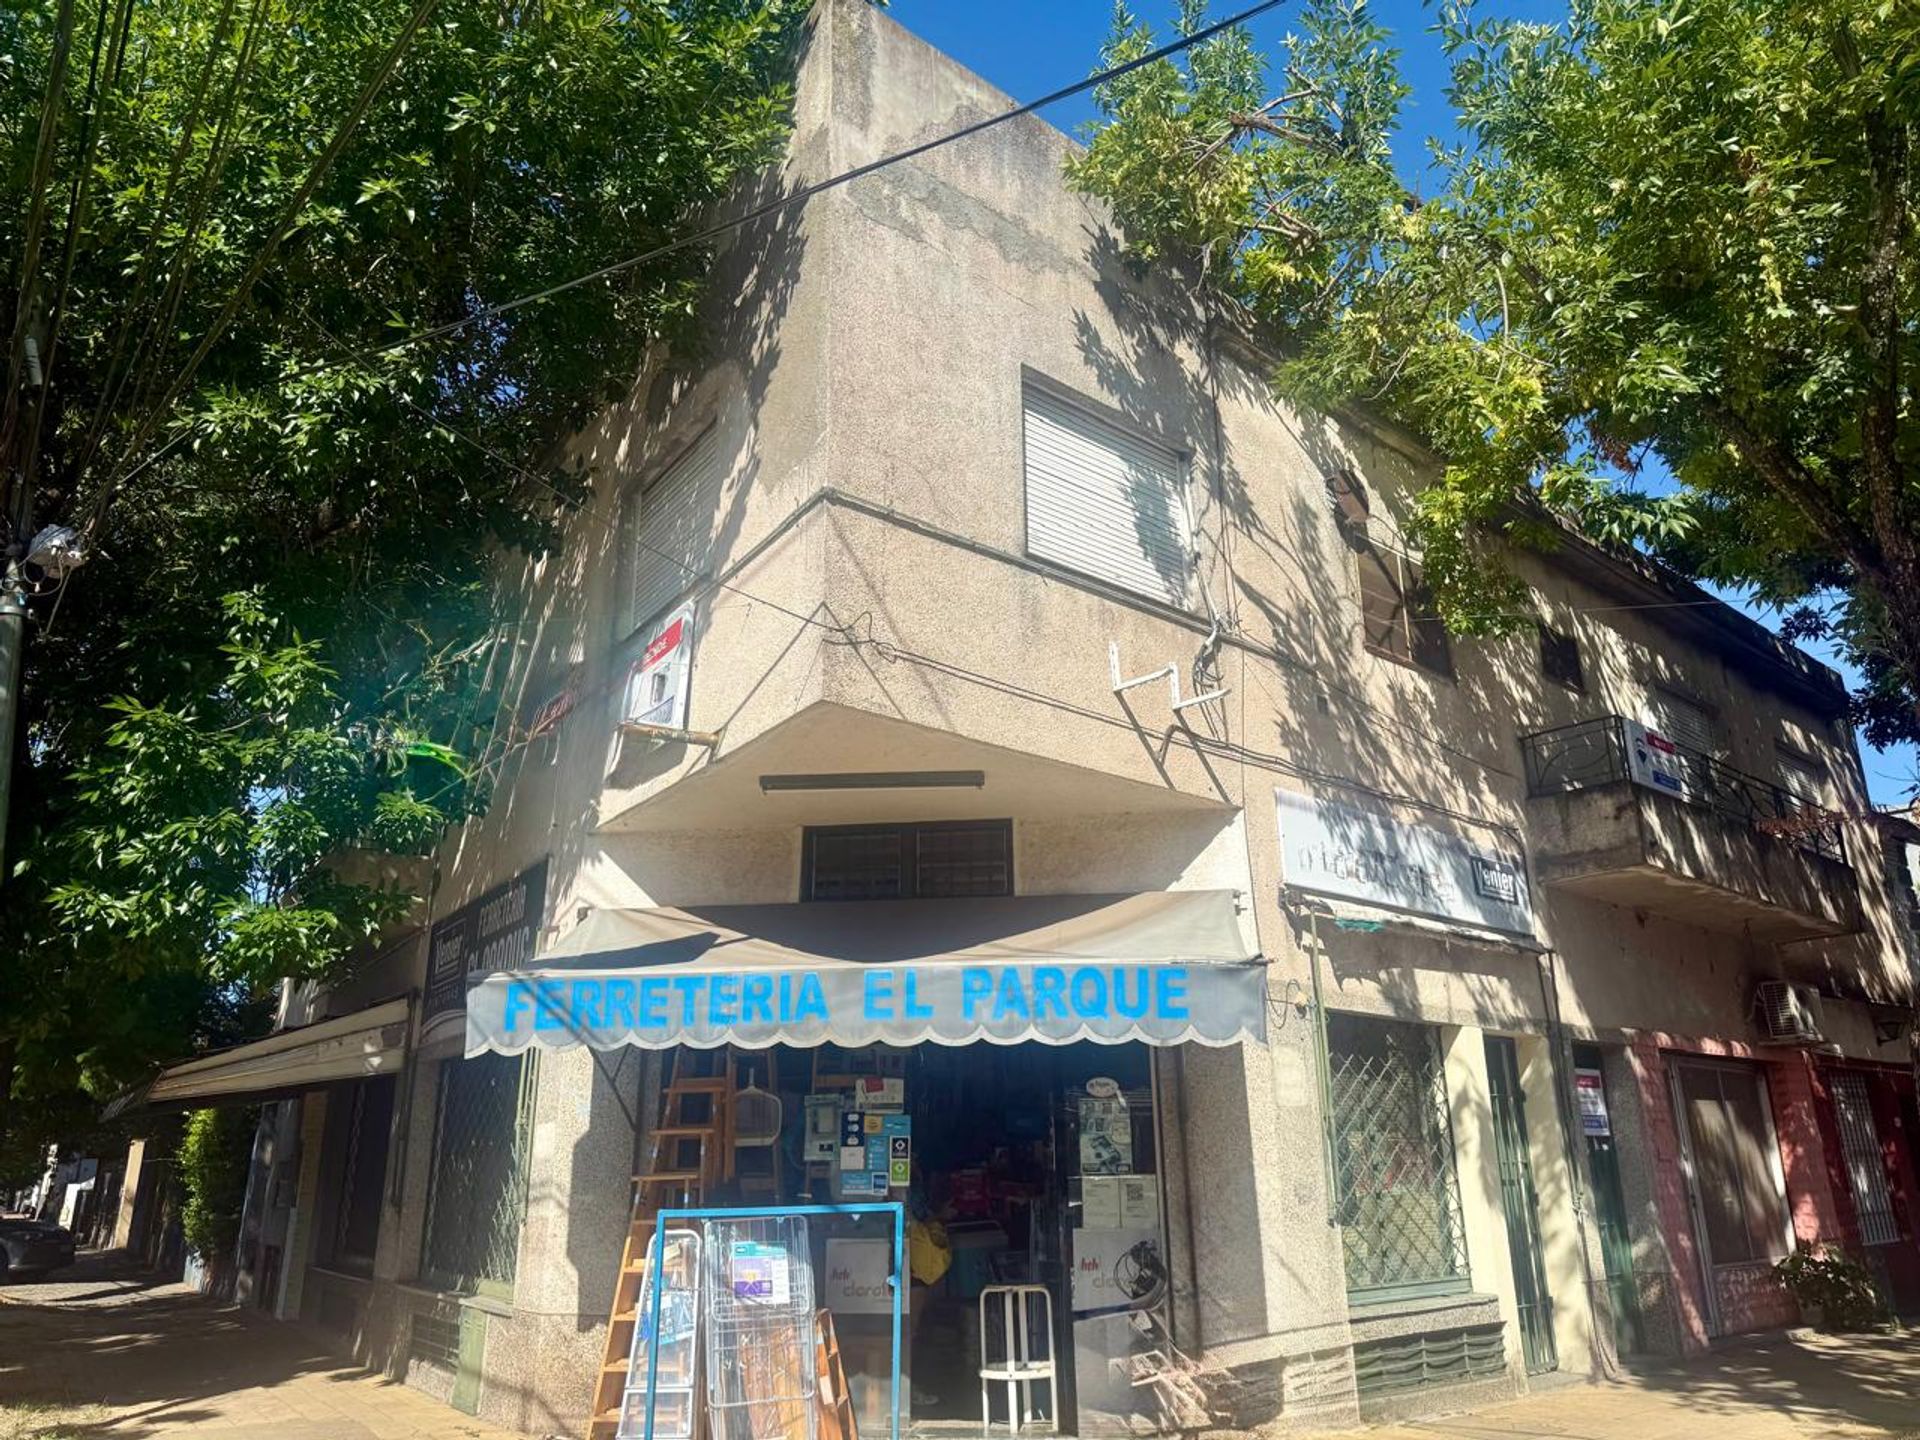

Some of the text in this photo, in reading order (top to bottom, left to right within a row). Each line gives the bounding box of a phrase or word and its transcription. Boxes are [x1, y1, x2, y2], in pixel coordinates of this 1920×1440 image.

[1472, 859, 1514, 893] Venier
[504, 972, 831, 1033] FERRETERIA
[863, 969, 935, 1021] EL
[961, 966, 1190, 1021] PARQUE
